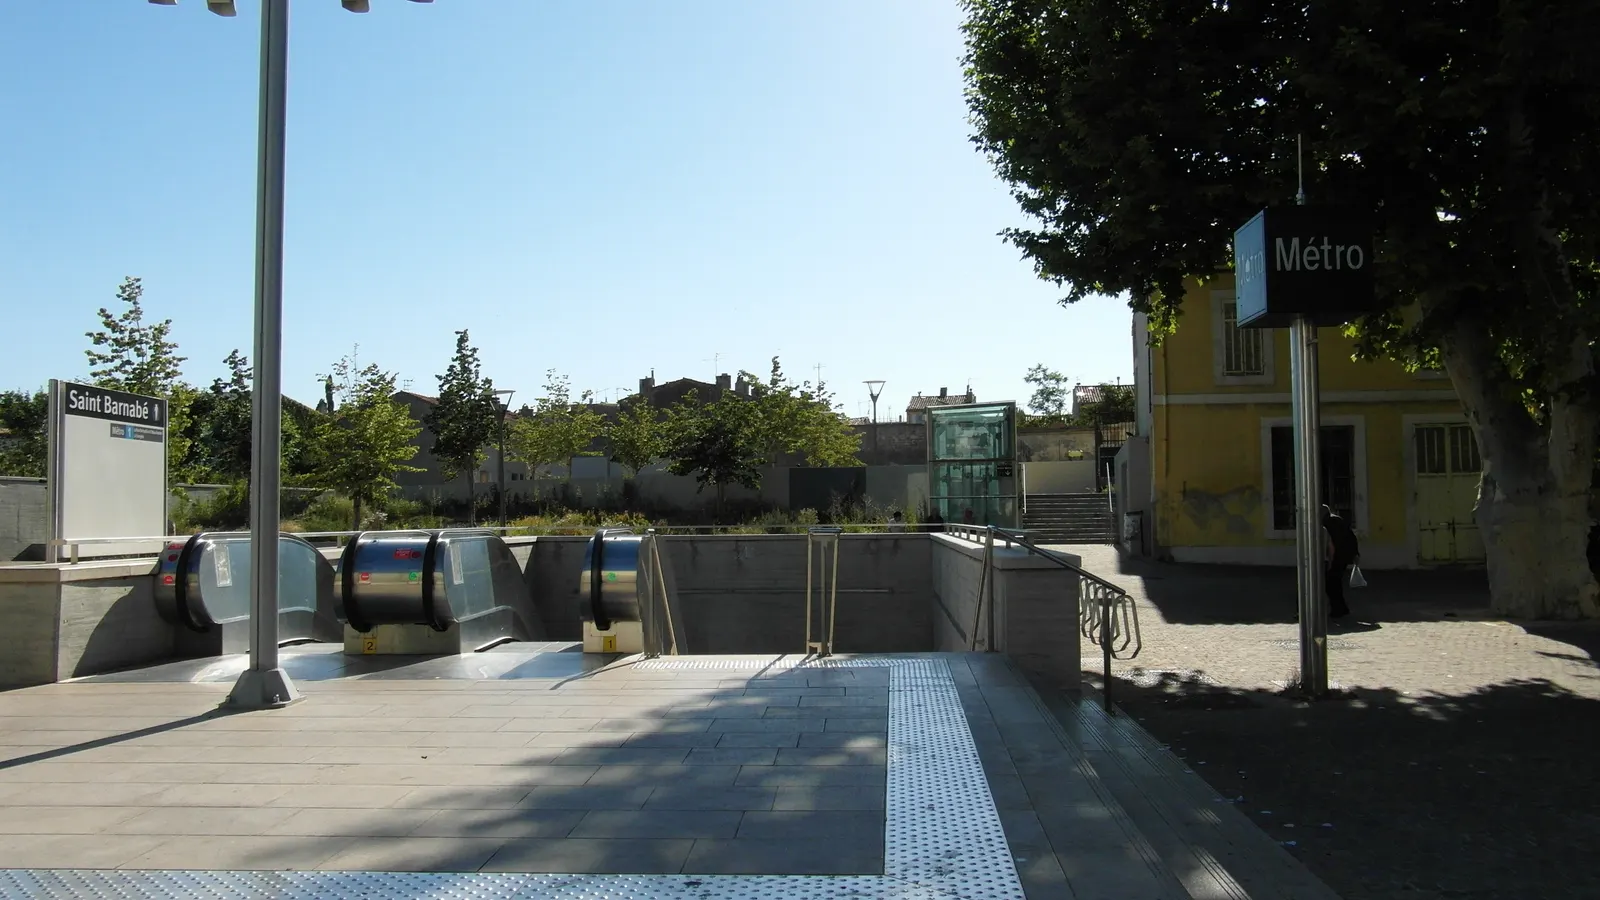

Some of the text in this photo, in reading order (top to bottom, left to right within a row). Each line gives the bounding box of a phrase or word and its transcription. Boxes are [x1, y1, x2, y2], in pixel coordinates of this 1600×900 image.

[1275, 236, 1364, 272] Métro
[69, 389, 149, 420] Saint Barnabé
[366, 641, 374, 651] 2
[608, 640, 612, 649] 1
